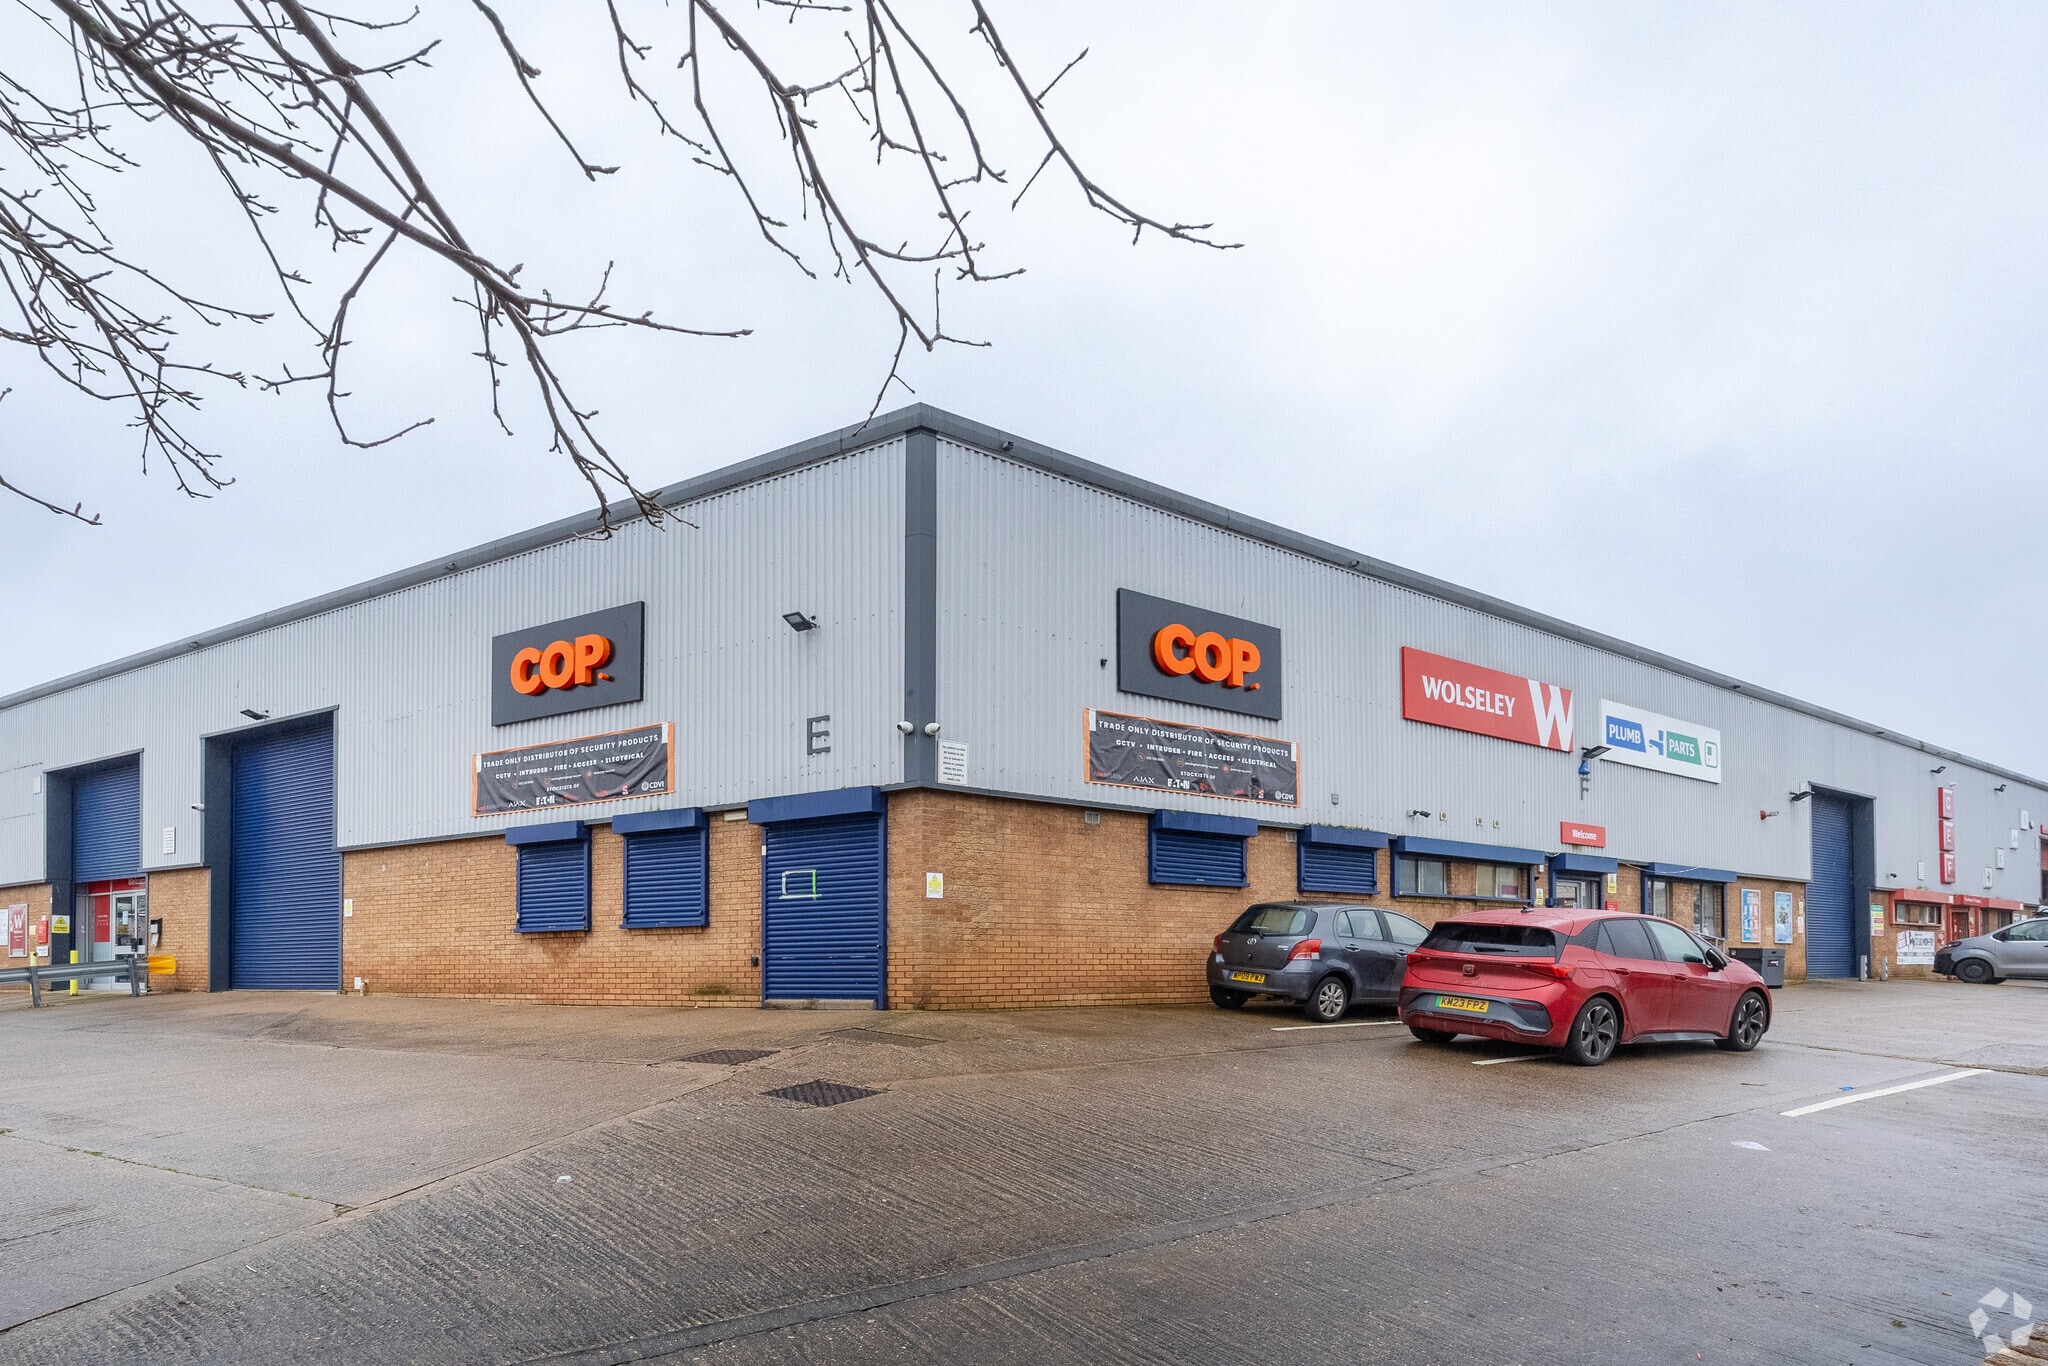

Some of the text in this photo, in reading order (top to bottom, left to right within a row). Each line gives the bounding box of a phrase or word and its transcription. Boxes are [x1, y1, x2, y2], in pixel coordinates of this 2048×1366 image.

[1421, 675, 1515, 718] WOLSELEY
[806, 714, 831, 756] E
[1098, 720, 1289, 757] TRADE ONLY DISTRIBUTOR OF SECURITY PRODUCTS
[1609, 723, 1695, 757] PLUMB PARTS
[483, 734, 659, 769] TRADE ONLY DISTRIBUTOR OF SECURITY PRODUCTS
[495, 752, 644, 780] CCTV INTRUDER FIRE ACCESS ELECTRICAL
[1115, 739, 1277, 769] CCTV INTRUDER FIRE ACCESS ELECTRICAL
[1133, 775, 1155, 784] AJAX
[1571, 829, 1597, 841] Welcome
[1440, 997, 1487, 1010] KM23 FPZ
